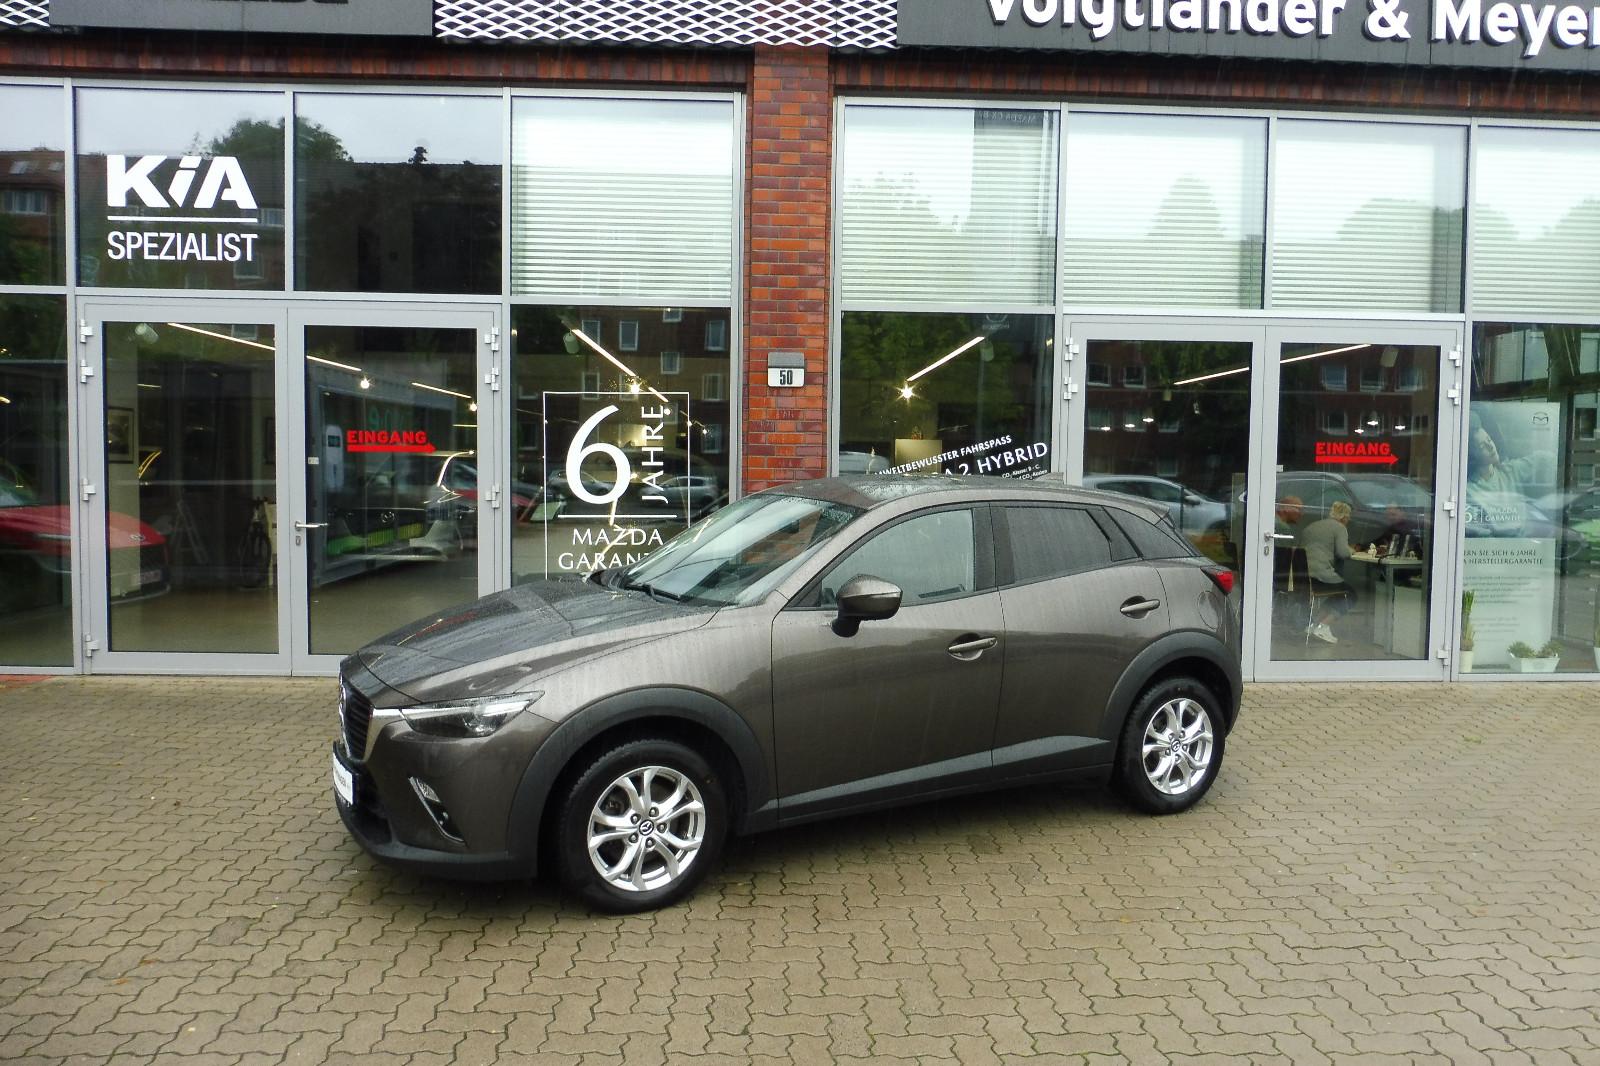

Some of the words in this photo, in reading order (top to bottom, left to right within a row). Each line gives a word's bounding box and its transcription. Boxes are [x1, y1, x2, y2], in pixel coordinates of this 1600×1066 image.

[1366, 0, 1411, 39] &
[107, 231, 258, 261] SPEZIALIST
[779, 369, 793, 386] 50
[346, 430, 427, 444] EINGANG
[1315, 442, 1391, 456] EINGANG
[565, 404, 631, 505] 6
[641, 404, 669, 504] JAHRE
[874, 450, 959, 476] WELTBEWUSSTER
[960, 434, 1012, 456] FAHRSPASS
[976, 442, 1048, 474] HYBRID
[572, 528, 664, 546] MAZDA
